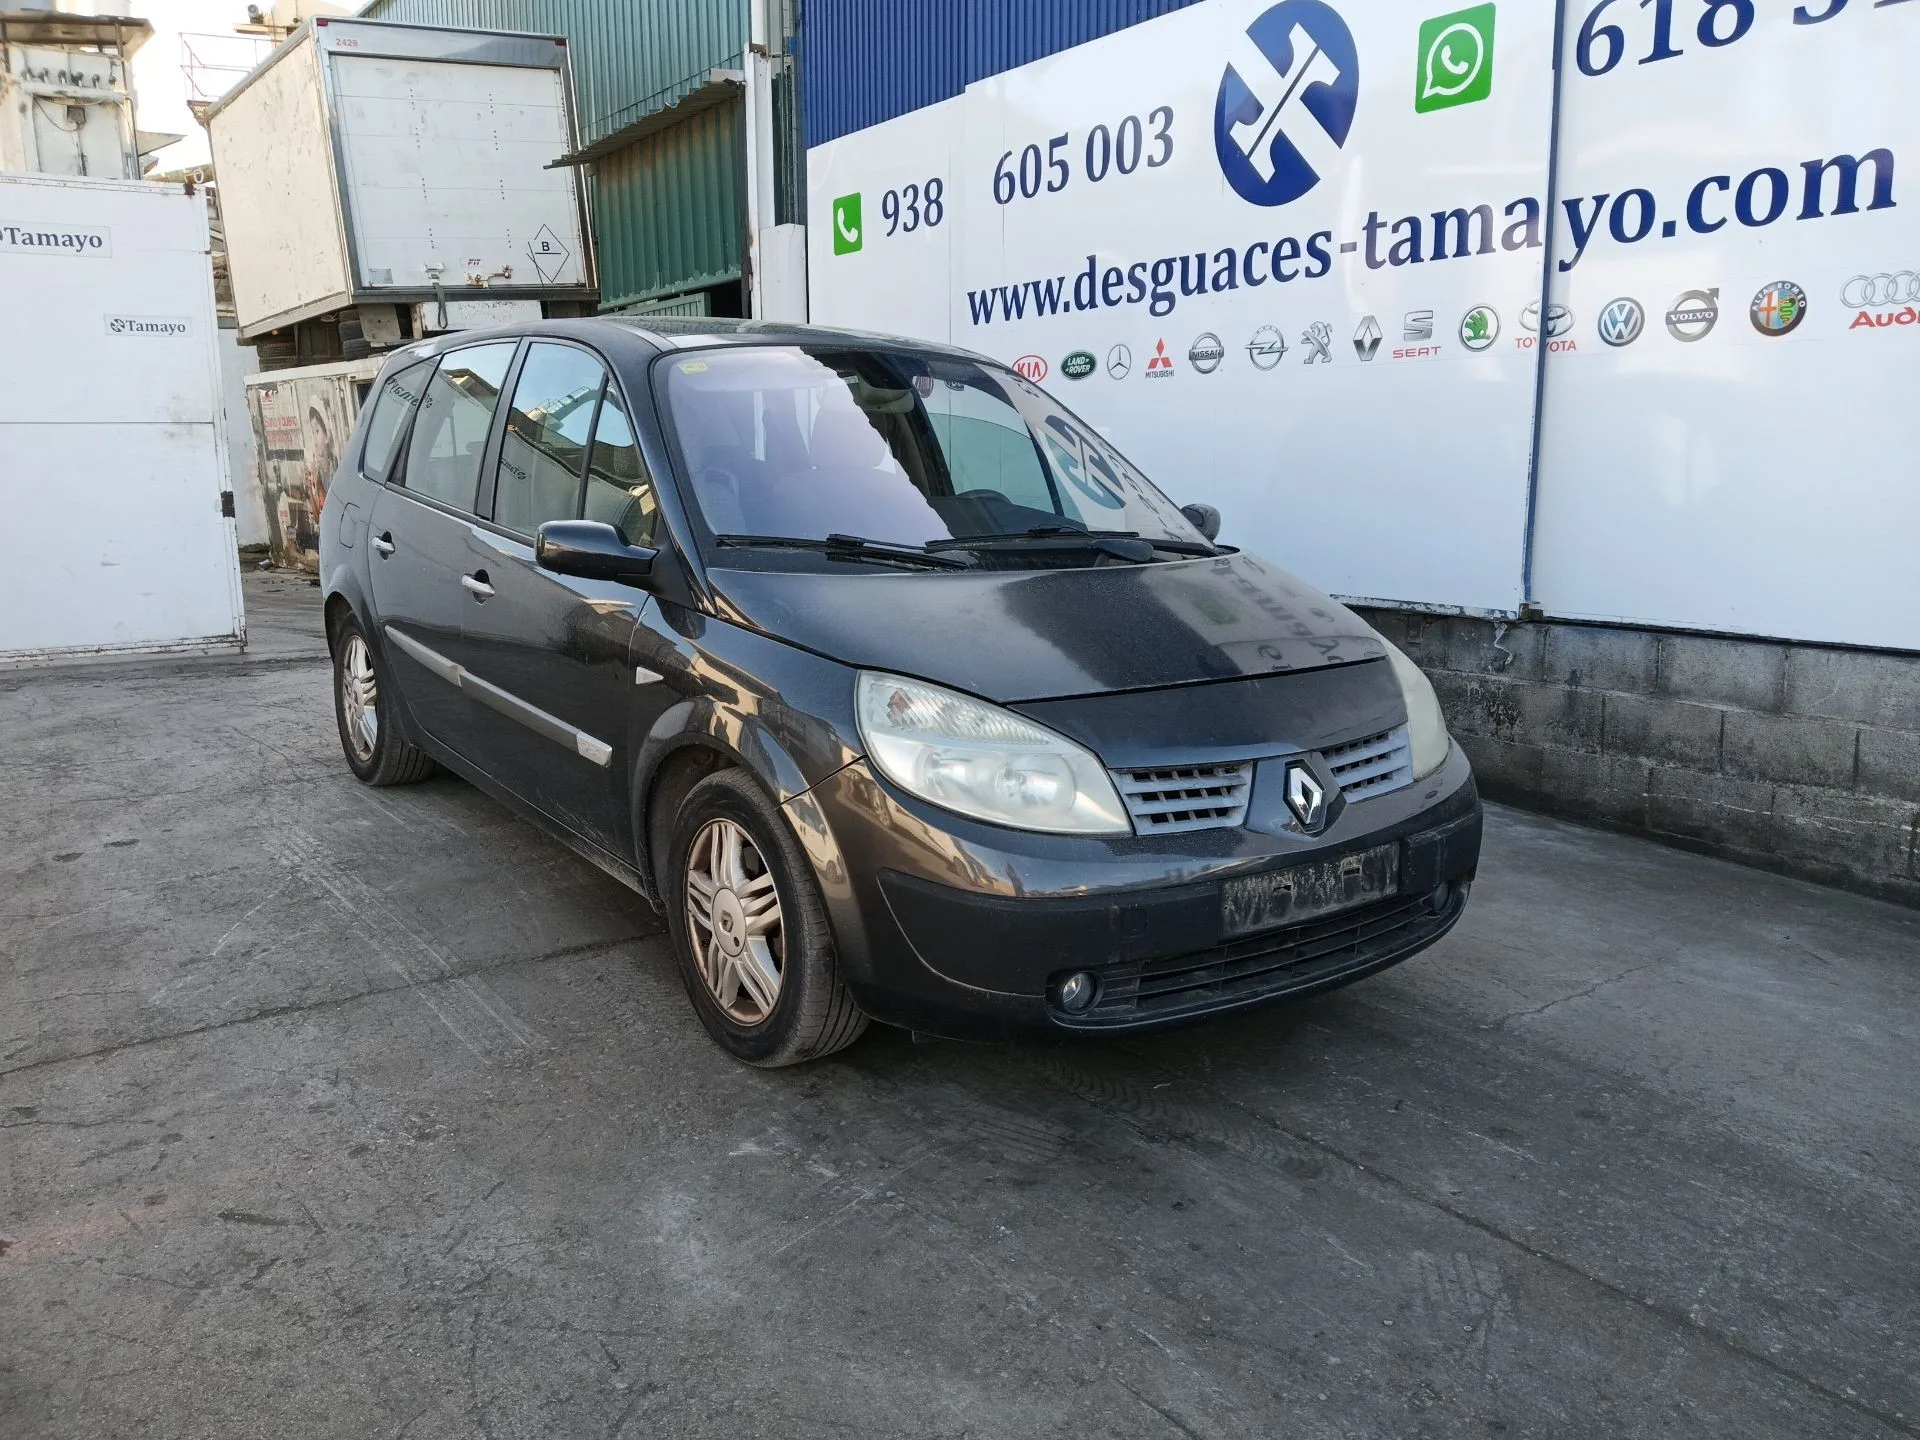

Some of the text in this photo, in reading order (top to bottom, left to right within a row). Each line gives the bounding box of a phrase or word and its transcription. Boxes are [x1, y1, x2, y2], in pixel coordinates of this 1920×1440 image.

[336, 38, 358, 48] 2429
[1575, 0, 1755, 77] 618
[881, 105, 1174, 238] 938 605 003
[3, 227, 103, 252] Tamayo
[966, 147, 1898, 325] www.desguaces-tamayo.com
[541, 241, 550, 252] B
[1777, 282, 1806, 308] ROMEO
[1670, 311, 1714, 322] VOLVO
[125, 319, 186, 336] Tamayo
[1191, 349, 1222, 358] NISSAN
[1392, 346, 1442, 359] SEAT
[1067, 356, 1086, 366] LAND
[1017, 361, 1042, 378] KIA
[1068, 364, 1091, 374] ROVER
[1145, 369, 1175, 379] MITSUBISHI
